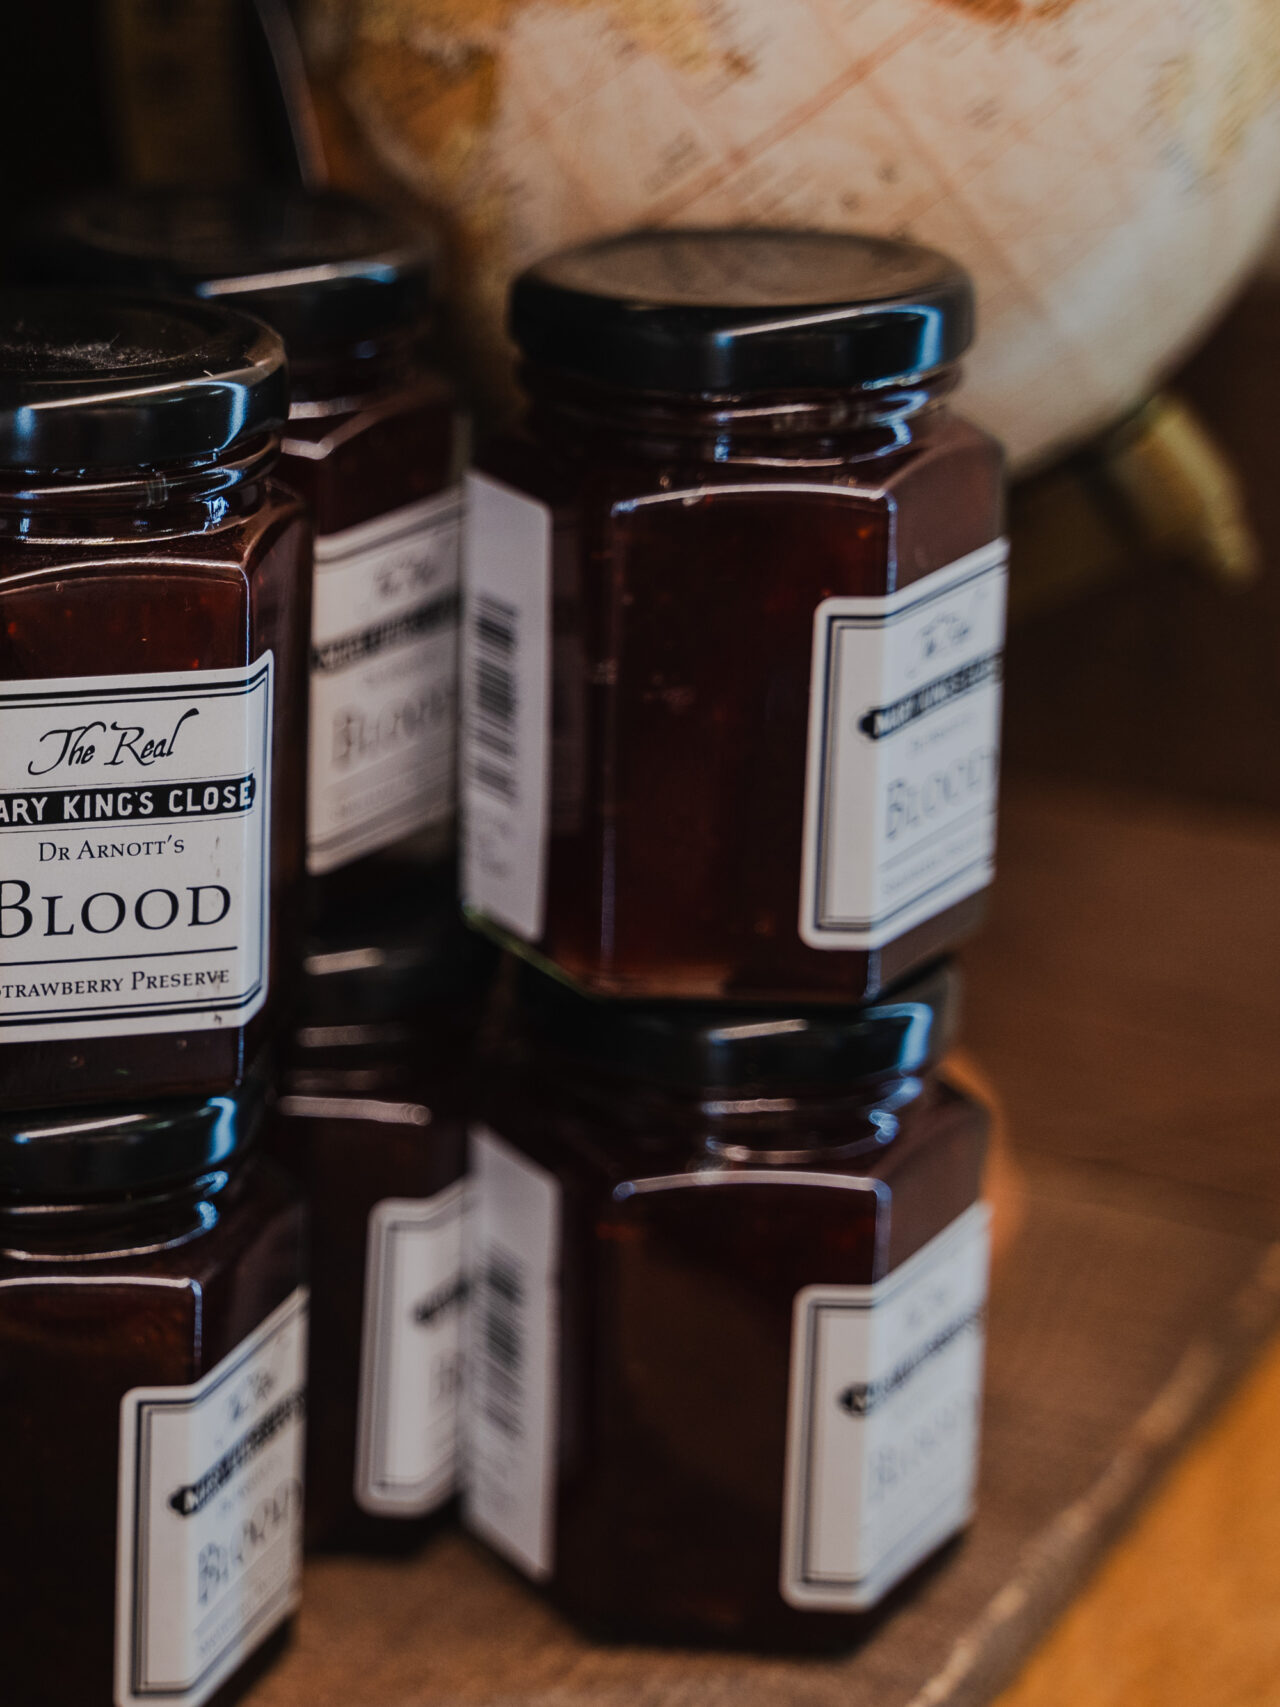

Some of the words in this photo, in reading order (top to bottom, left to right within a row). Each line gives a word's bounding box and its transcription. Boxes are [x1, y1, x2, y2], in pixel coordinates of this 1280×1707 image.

[28, 721, 106, 775] The
[105, 708, 200, 766] Real
[63, 789, 154, 820] KING'S
[168, 780, 253, 813] CLOSE
[39, 841, 70, 862] DR
[77, 834, 185, 860] ARNOTT'S
[131, 968, 230, 991] PRESERVE
